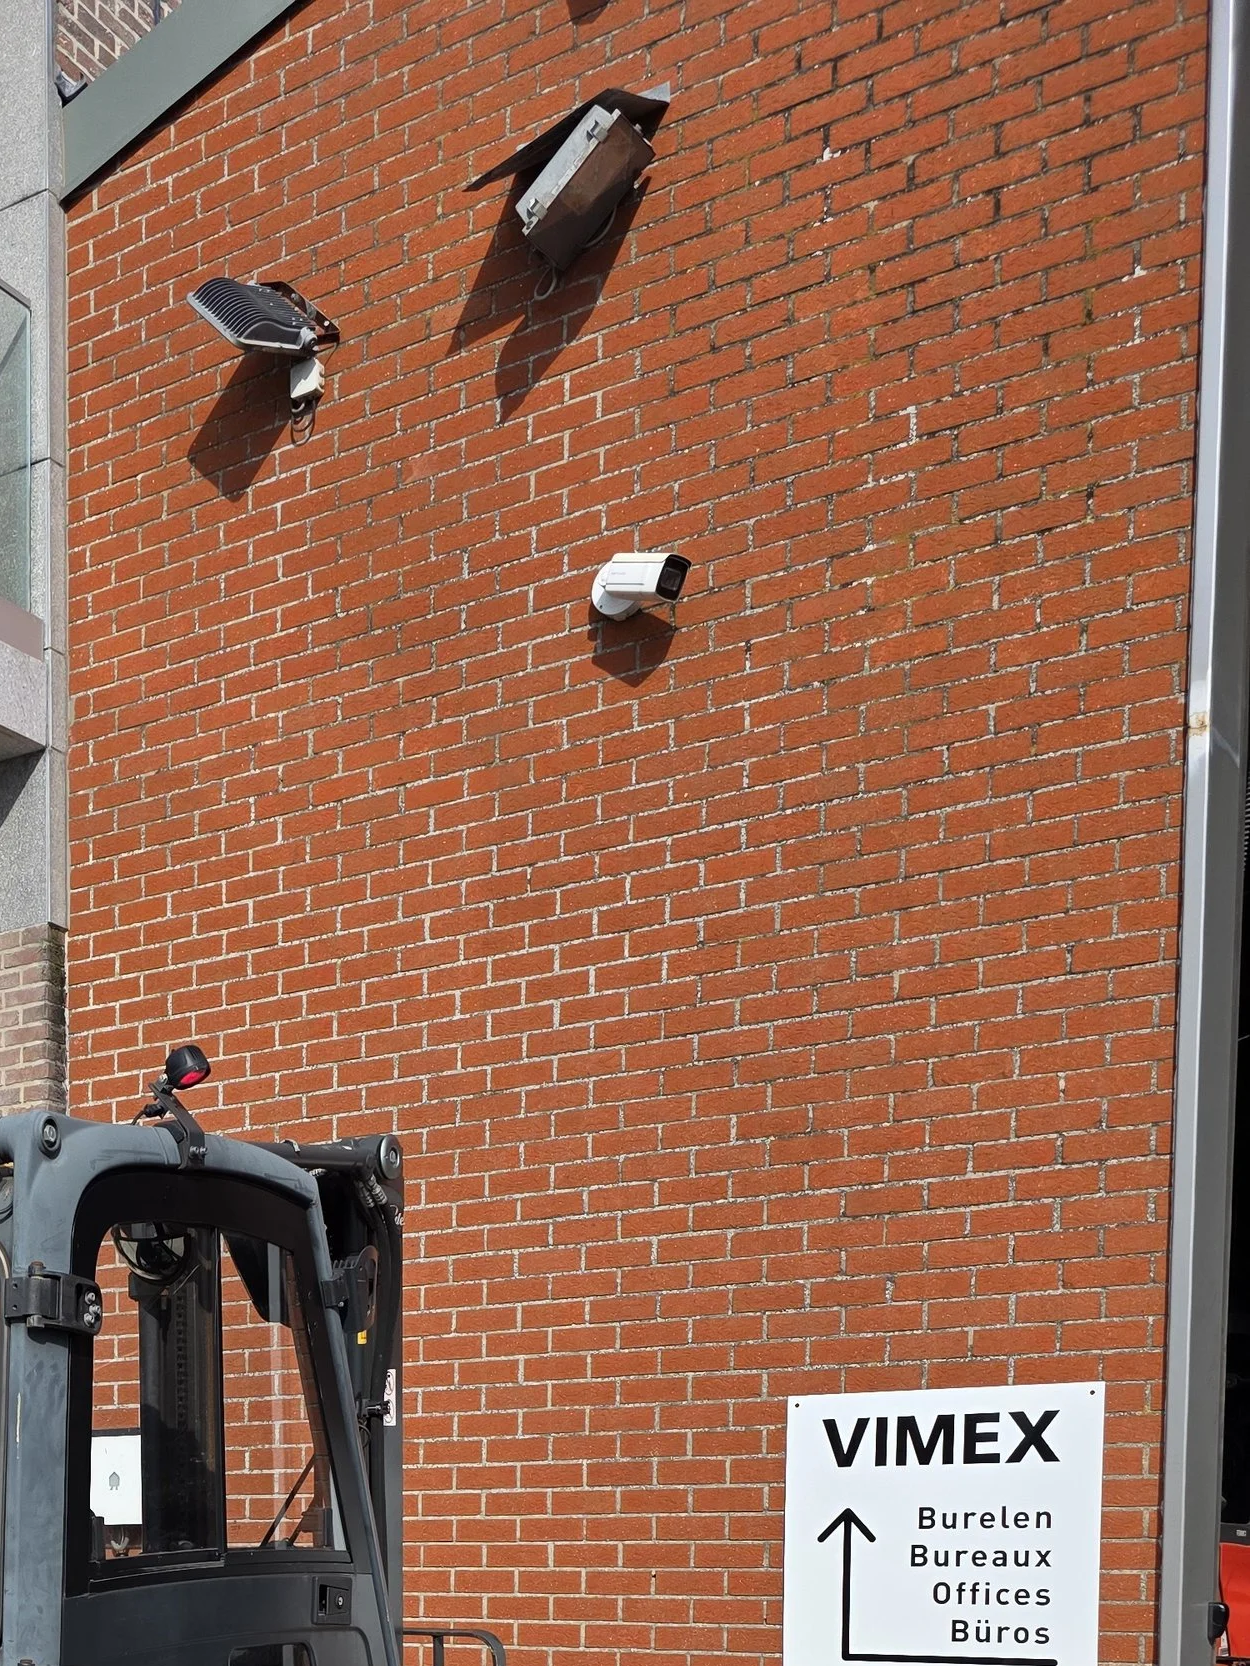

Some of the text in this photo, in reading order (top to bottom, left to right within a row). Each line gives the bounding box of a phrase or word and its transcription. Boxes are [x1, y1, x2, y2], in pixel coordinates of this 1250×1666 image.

[822, 1409, 1061, 1468] VIMEX
[918, 1505, 1052, 1530] Burelen
[910, 1544, 1052, 1568] Bureaux
[932, 1581, 1051, 1606] Offices
[951, 1619, 1050, 1645] Büros
